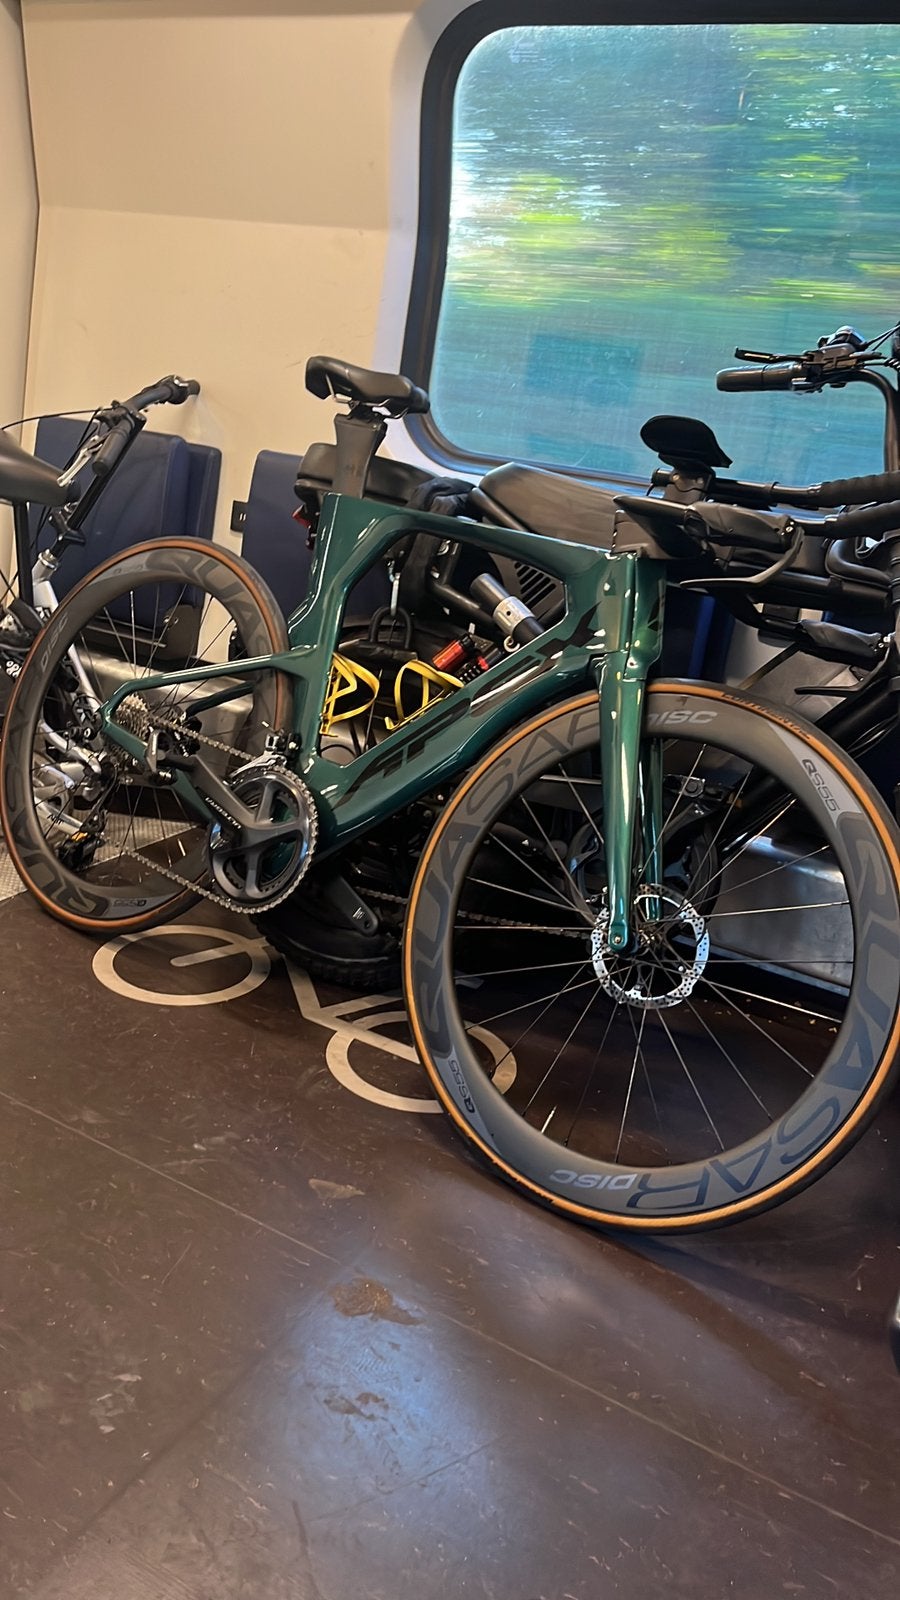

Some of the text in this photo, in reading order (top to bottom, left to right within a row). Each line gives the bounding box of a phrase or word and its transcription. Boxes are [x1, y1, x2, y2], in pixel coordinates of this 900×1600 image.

[41, 613, 69, 669] DISC
[802, 758, 840, 811] QS55
[626, 811, 899, 1210] QUASAR
[450, 1059, 475, 1114] QS55
[551, 1168, 638, 1190] DISC
